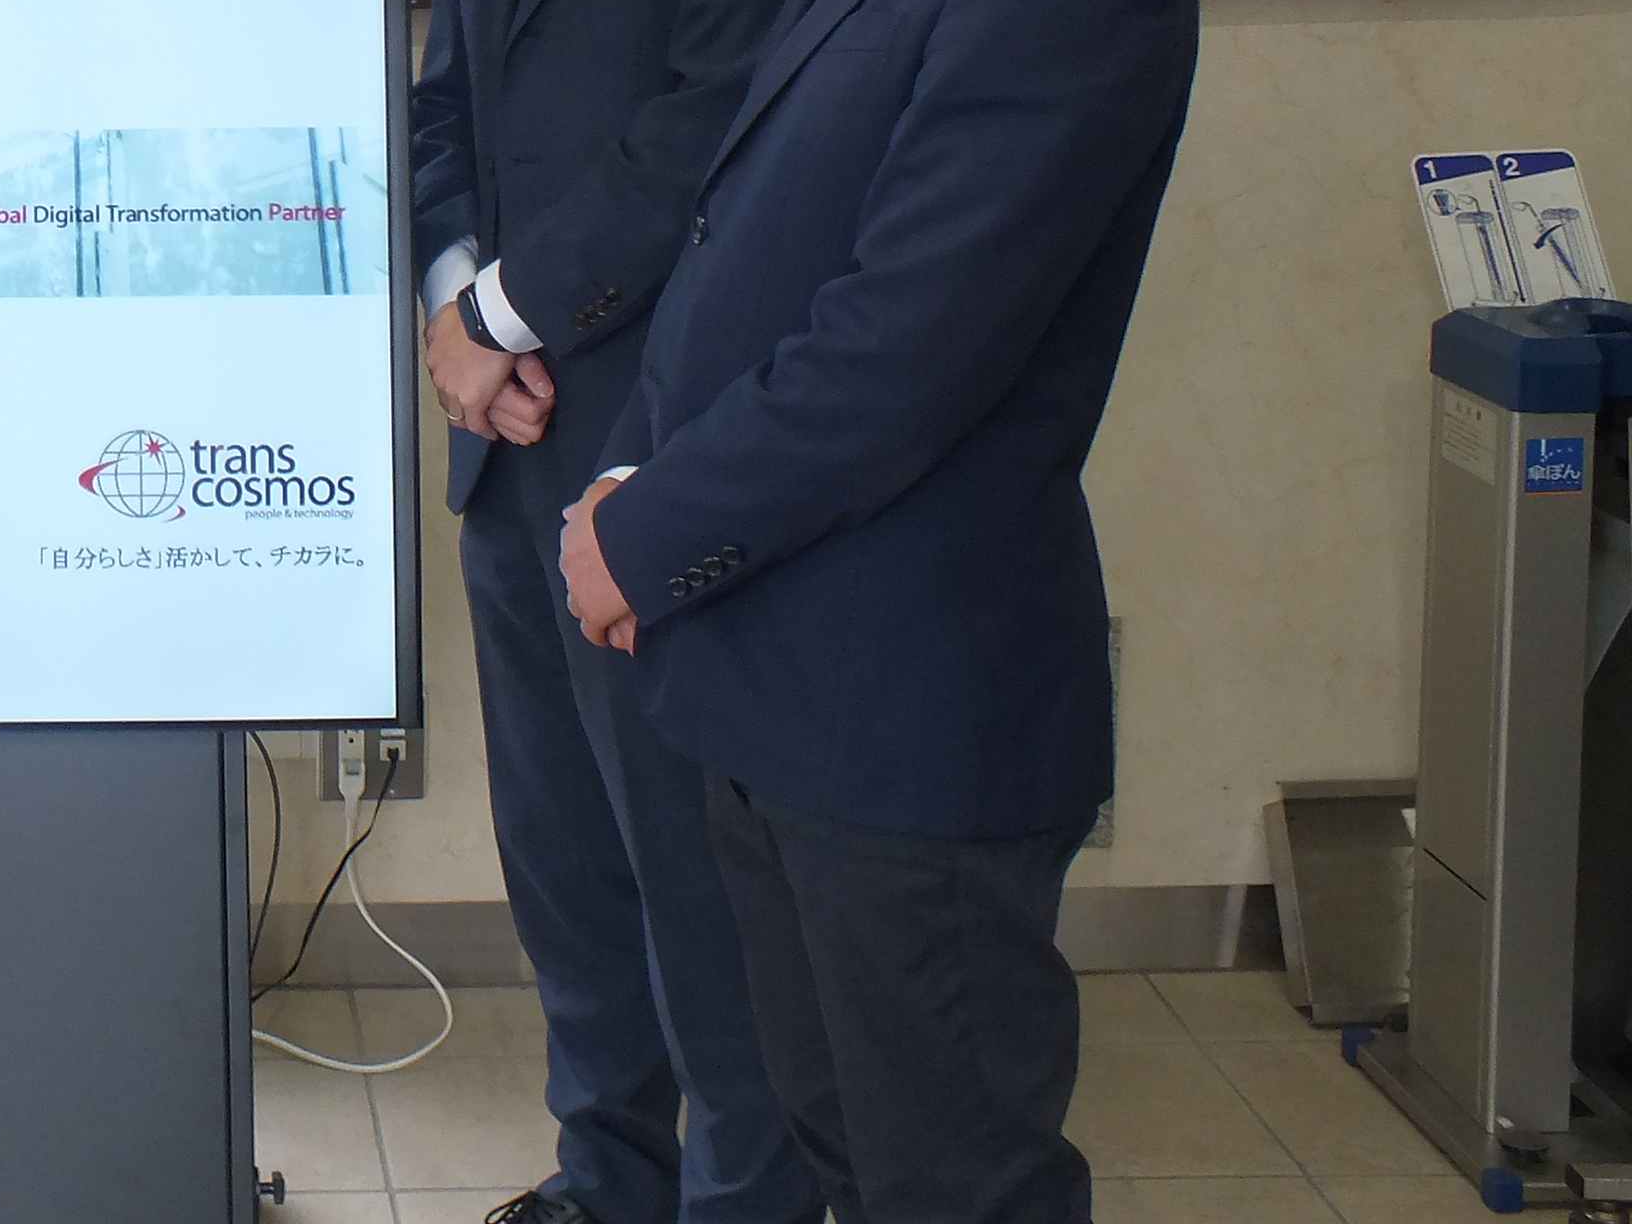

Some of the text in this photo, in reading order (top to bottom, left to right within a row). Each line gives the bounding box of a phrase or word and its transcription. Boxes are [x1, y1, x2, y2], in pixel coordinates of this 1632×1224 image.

[33, 204, 100, 228] Digital
[105, 203, 263, 224] Transformation
[268, 202, 347, 222] Partner
[190, 440, 296, 475] trans
[191, 475, 356, 508] cosmos
[244, 508, 282, 521] people
[294, 507, 355, 520] technology
[38, 545, 365, 571] 「自分らしさ」活かして、チカラに。
